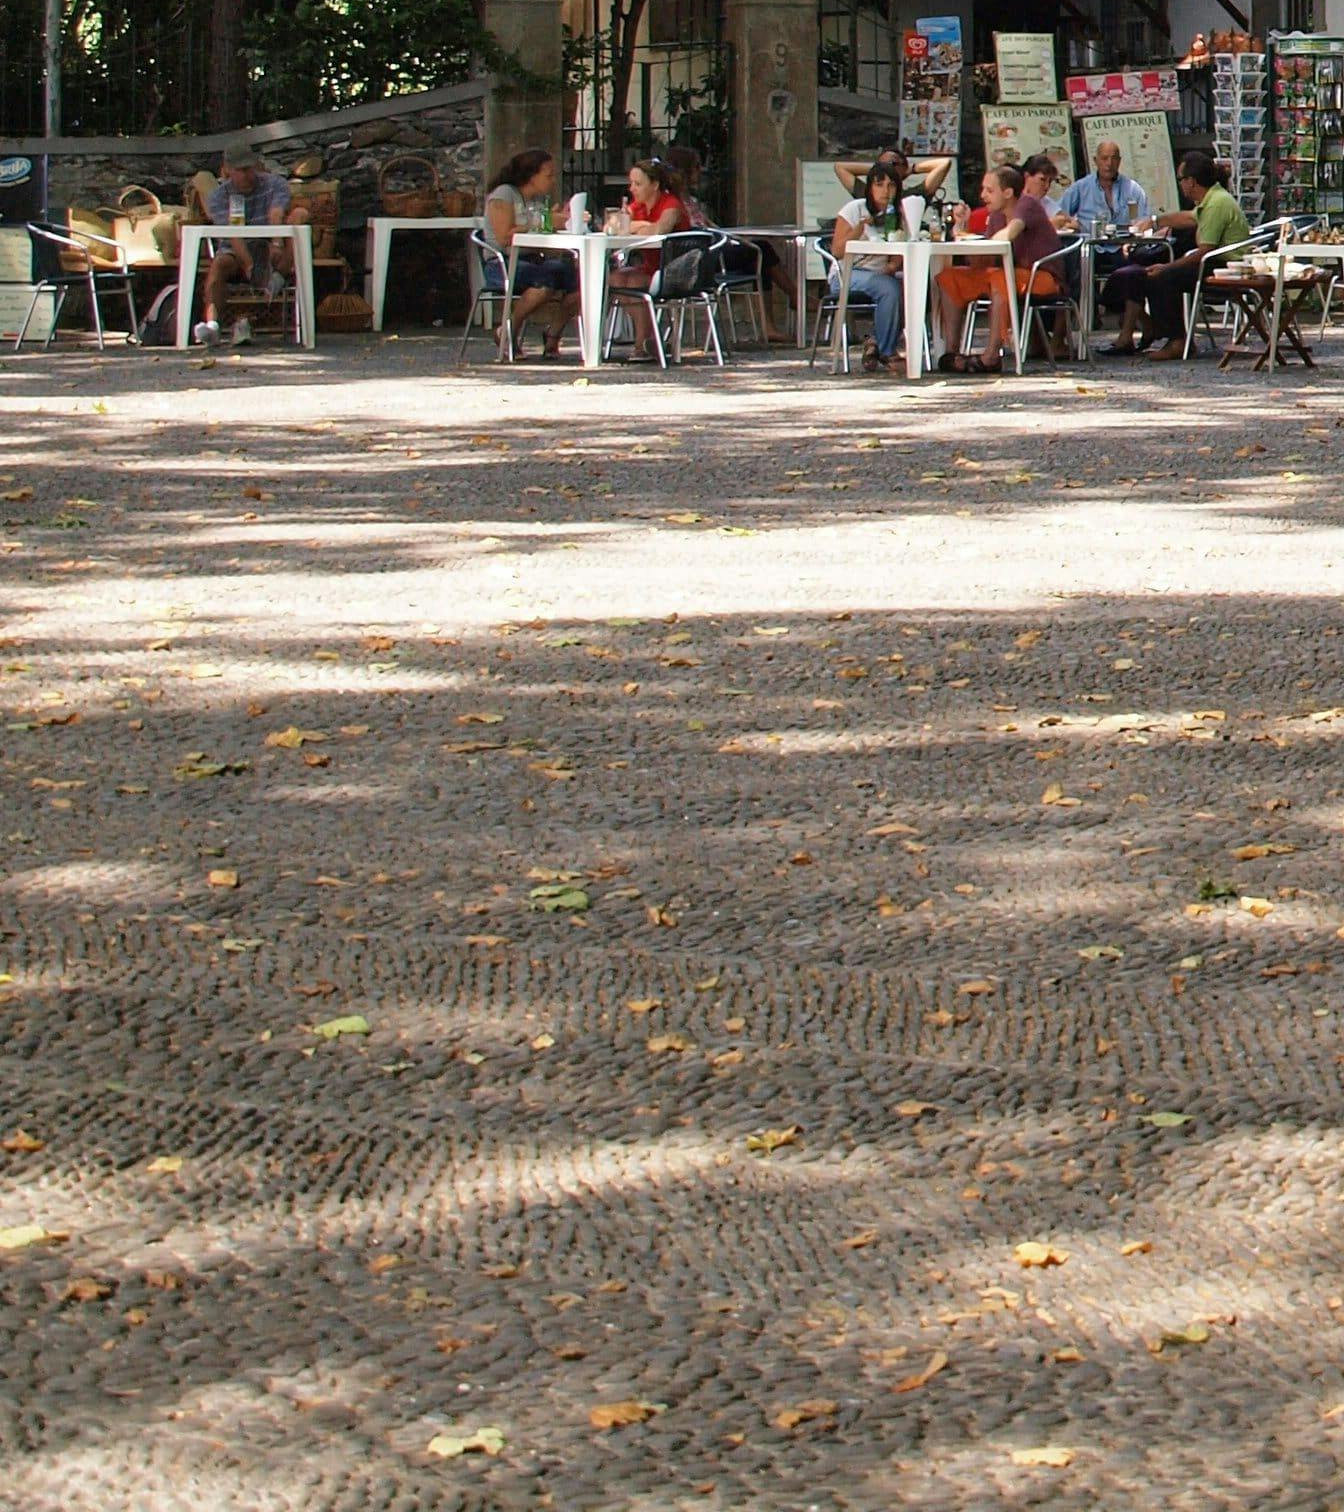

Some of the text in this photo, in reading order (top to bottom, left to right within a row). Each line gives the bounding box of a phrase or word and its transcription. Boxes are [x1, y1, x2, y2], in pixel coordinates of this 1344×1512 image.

[1012, 108, 1026, 118] DO
[1028, 108, 1063, 118] PARQUE
[1111, 117, 1125, 128] DO
[1127, 114, 1162, 128] PARQUE
